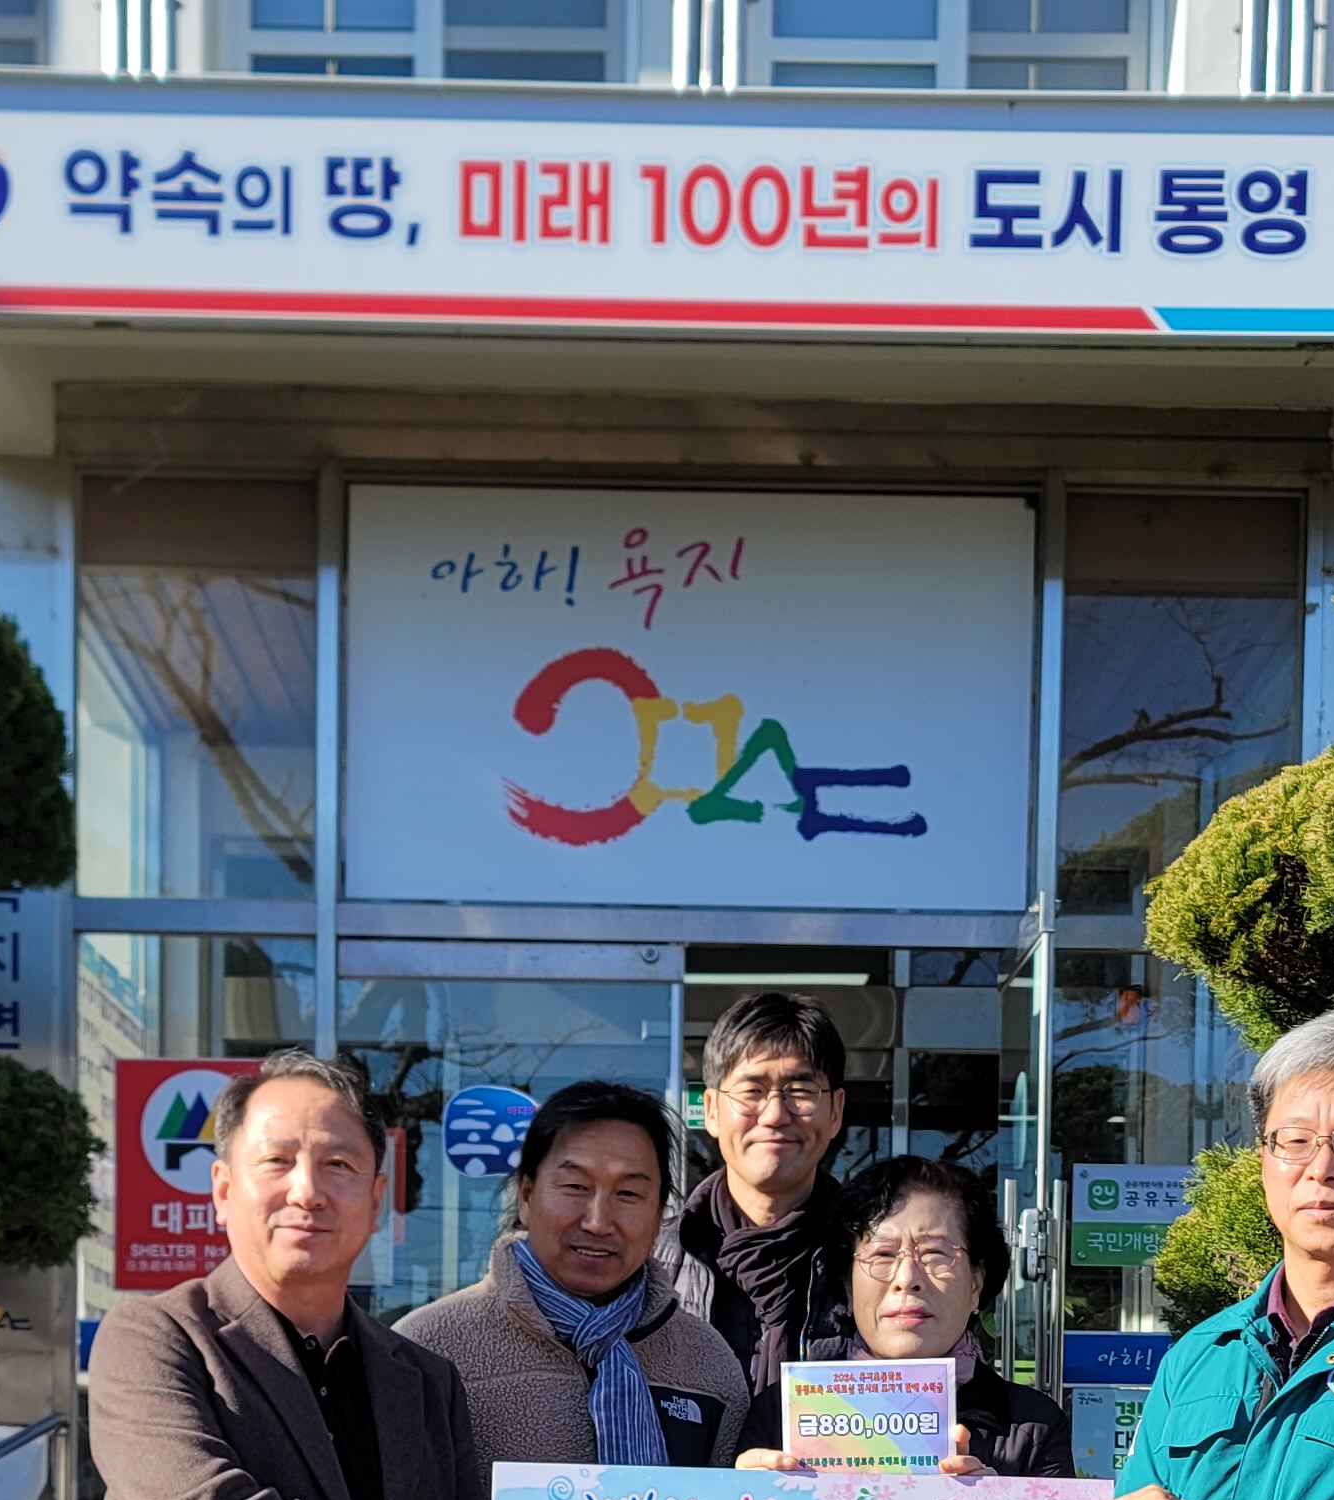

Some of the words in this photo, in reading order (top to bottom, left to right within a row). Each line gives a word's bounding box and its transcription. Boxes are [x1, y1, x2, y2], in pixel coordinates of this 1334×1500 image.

[64, 147, 293, 237] 약속의
[325, 156, 420, 248] 땅,
[459, 159, 613, 247] 미래
[639, 162, 940, 251] 100년의
[968, 167, 1123, 254] 도시
[1154, 167, 1310, 256] 통영
[430, 543, 581, 607] 아하!
[609, 527, 746, 630] 욕지
[1124, 1191, 1179, 1207] 공유누
[151, 1201, 227, 1235] 대피
[130, 1244, 196, 1257] SHELTER
[1097, 1348, 1153, 1371] 아하!
[660, 1400, 687, 1412] NORTH
[672, 1396, 687, 1405] THE
[669, 1408, 687, 1420] FACE
[798, 1412, 940, 1439] 금880,000원
